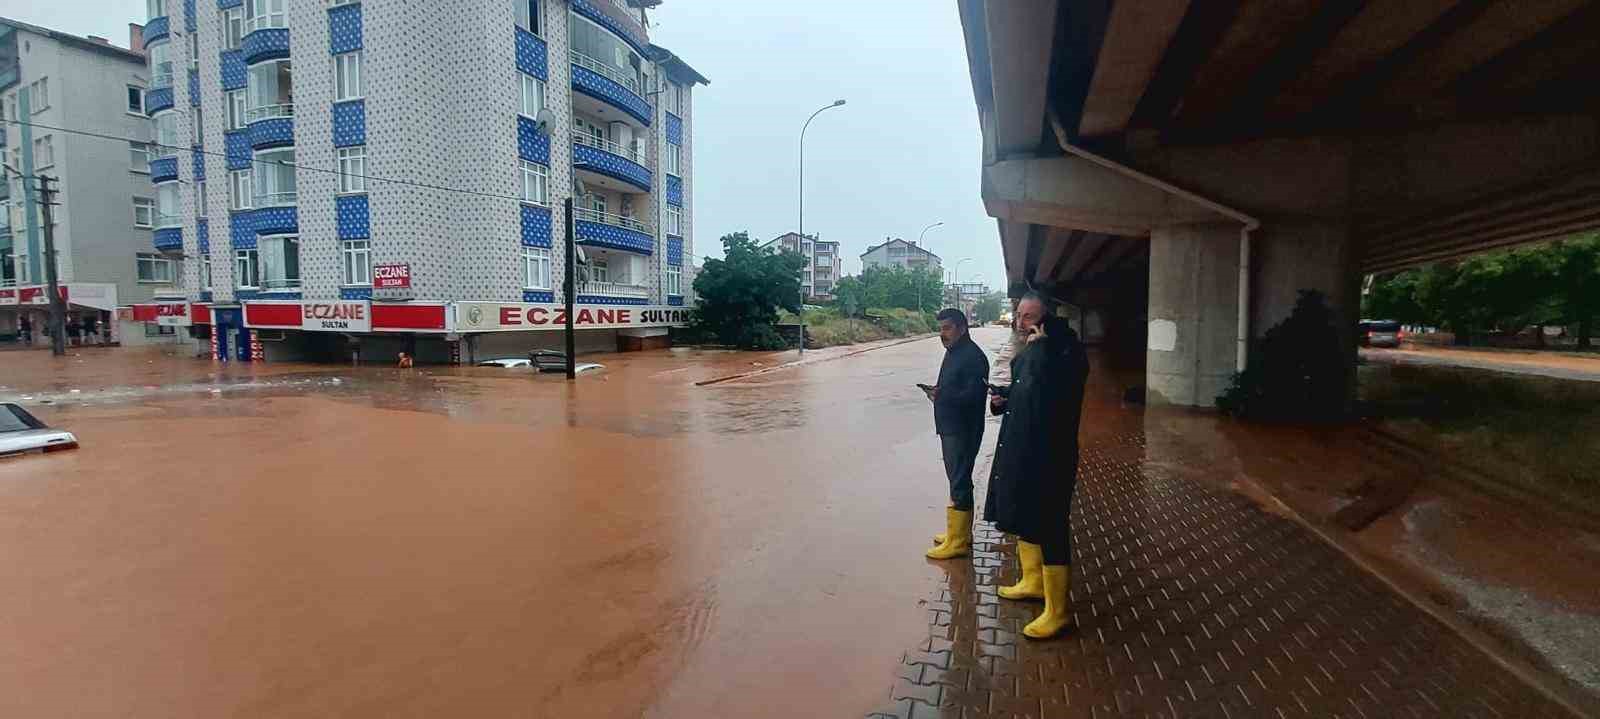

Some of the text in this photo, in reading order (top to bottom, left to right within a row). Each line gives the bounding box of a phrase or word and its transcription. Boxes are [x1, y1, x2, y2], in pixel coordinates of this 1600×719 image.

[375, 266, 408, 278] ECZANE
[304, 304, 364, 319] ECZANE
[499, 307, 690, 325] ECZANE SULTAN
[321, 320, 349, 328] SULTAN
